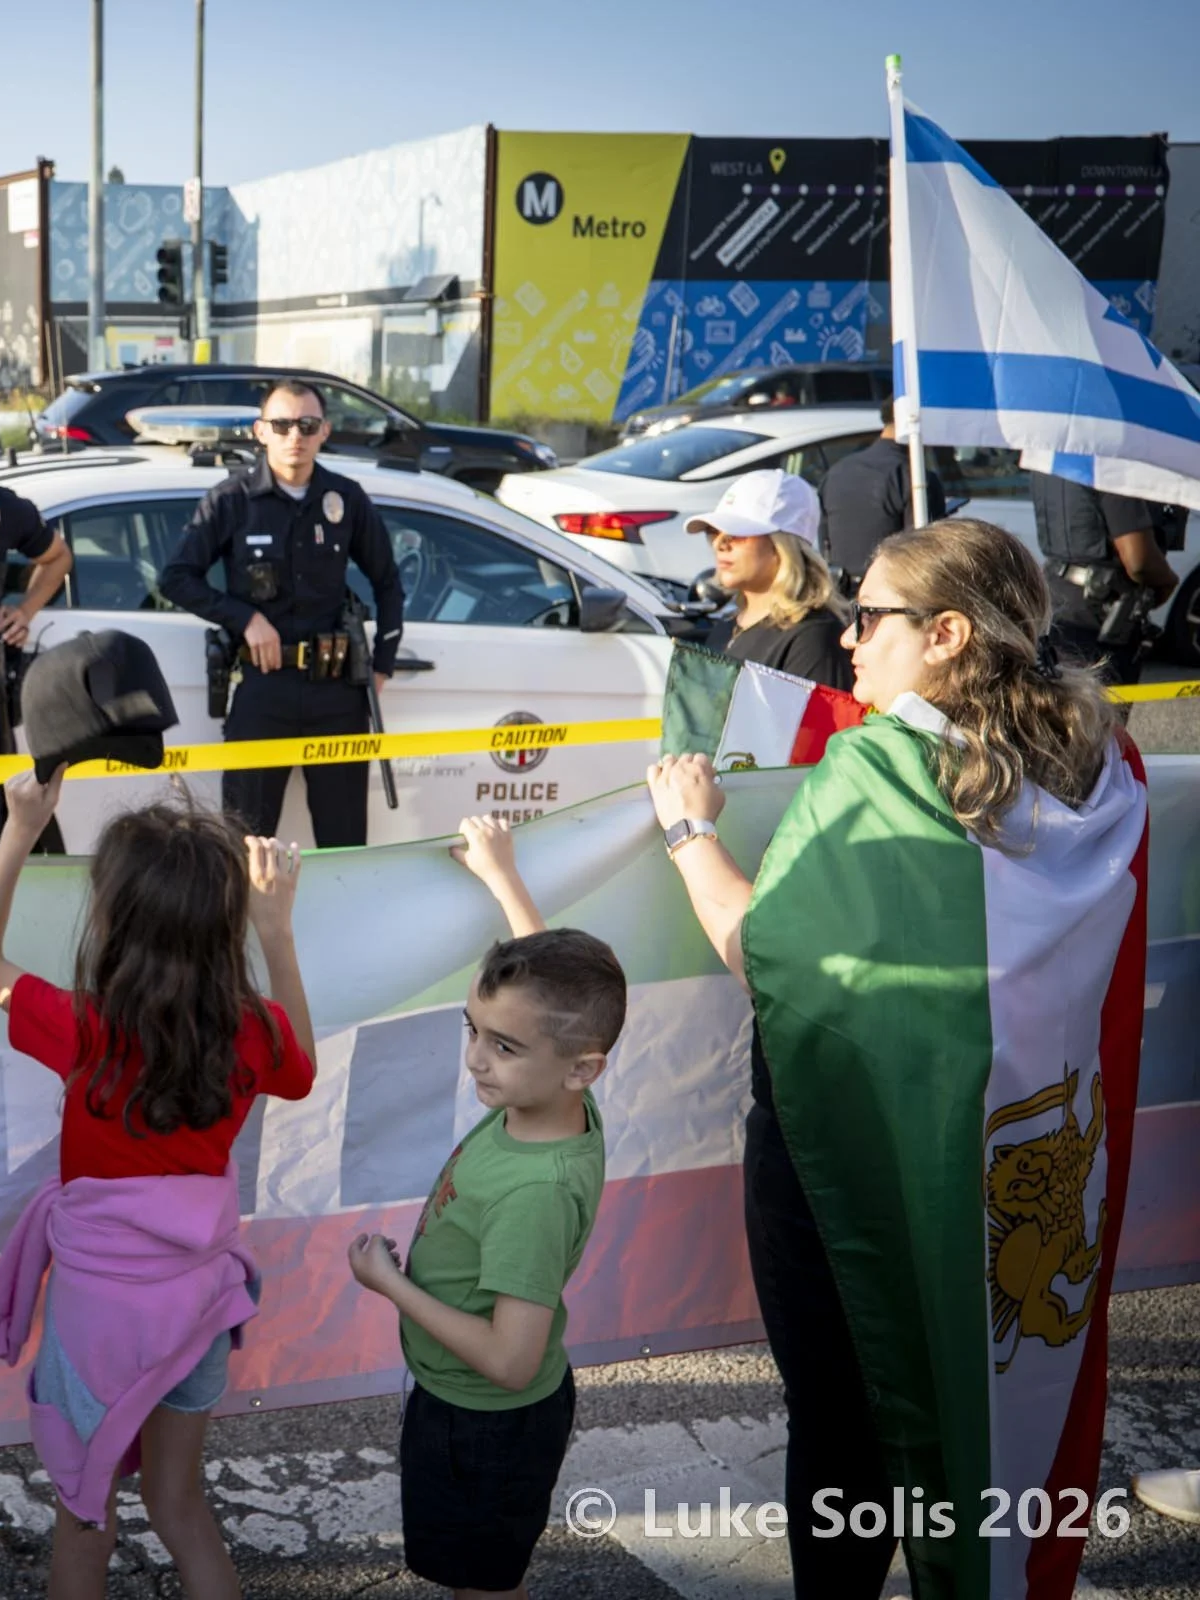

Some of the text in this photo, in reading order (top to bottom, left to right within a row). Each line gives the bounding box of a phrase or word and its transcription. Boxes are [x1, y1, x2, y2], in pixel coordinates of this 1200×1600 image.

[710, 161, 763, 176] WEST LA
[523, 180, 557, 217] M
[573, 216, 646, 238] Metro
[491, 727, 567, 747] CAUTION
[303, 739, 381, 760] CAUTION
[476, 783, 558, 801] POLICE
